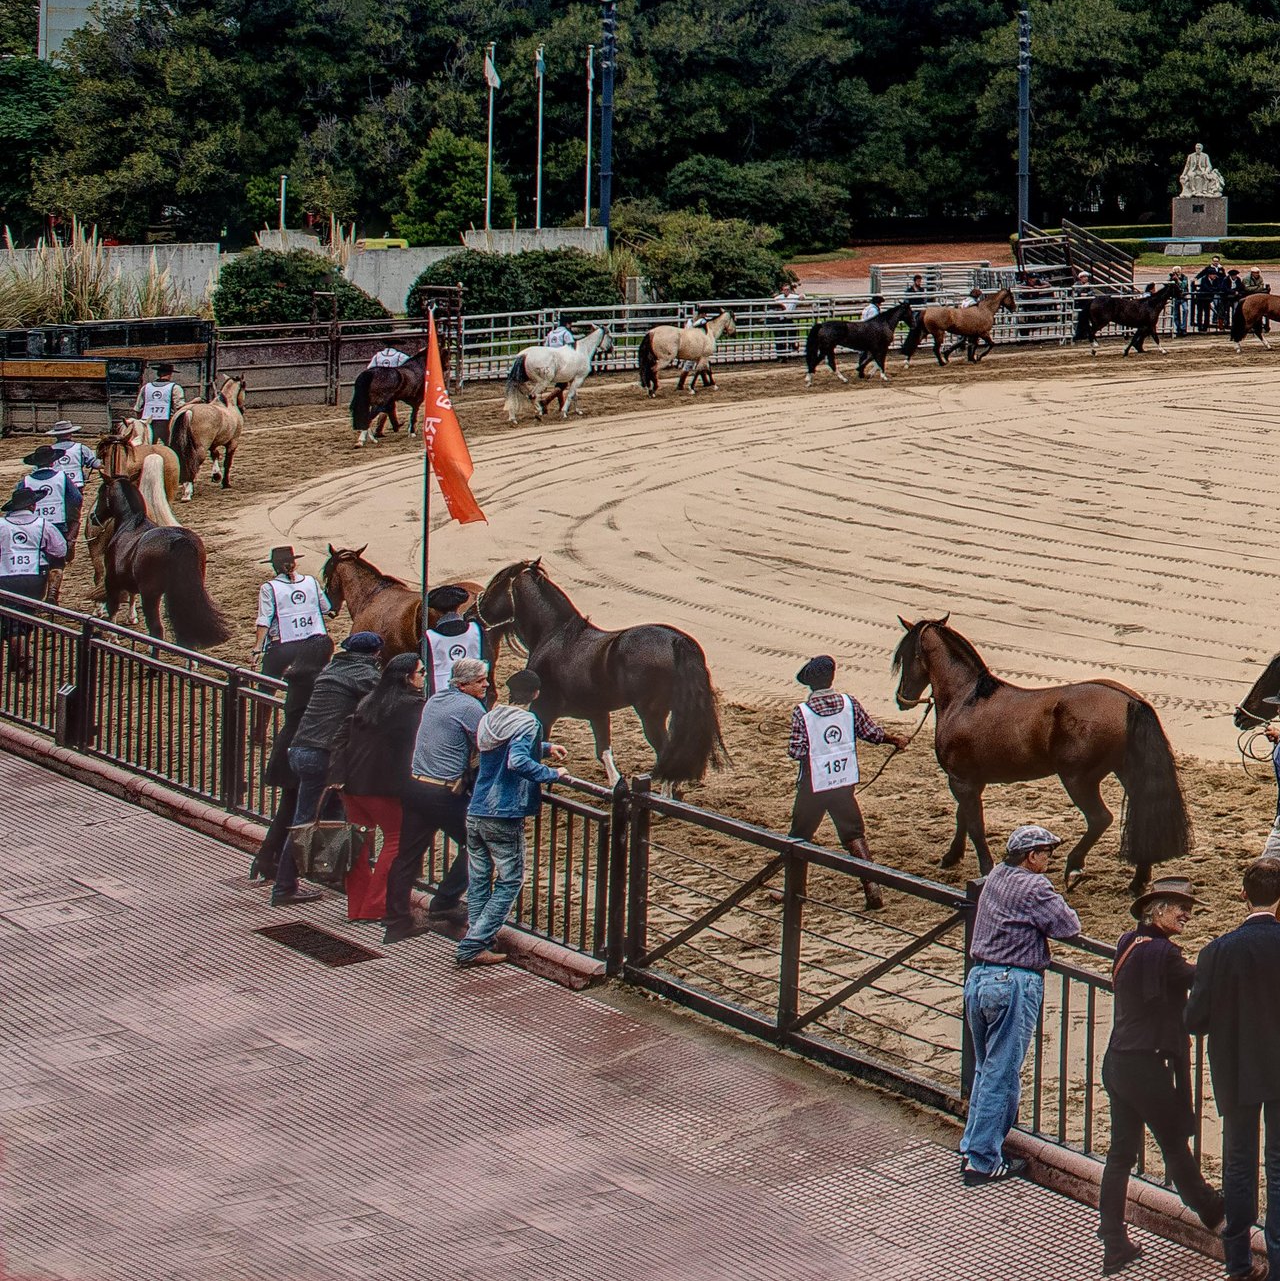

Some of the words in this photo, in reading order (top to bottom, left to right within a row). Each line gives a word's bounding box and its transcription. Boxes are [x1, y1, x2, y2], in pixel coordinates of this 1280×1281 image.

[151, 406, 165, 414] 177
[36, 506, 56, 516] 182
[10, 555, 30, 565] 183
[292, 616, 313, 629] 184
[824, 757, 848, 774] 187
